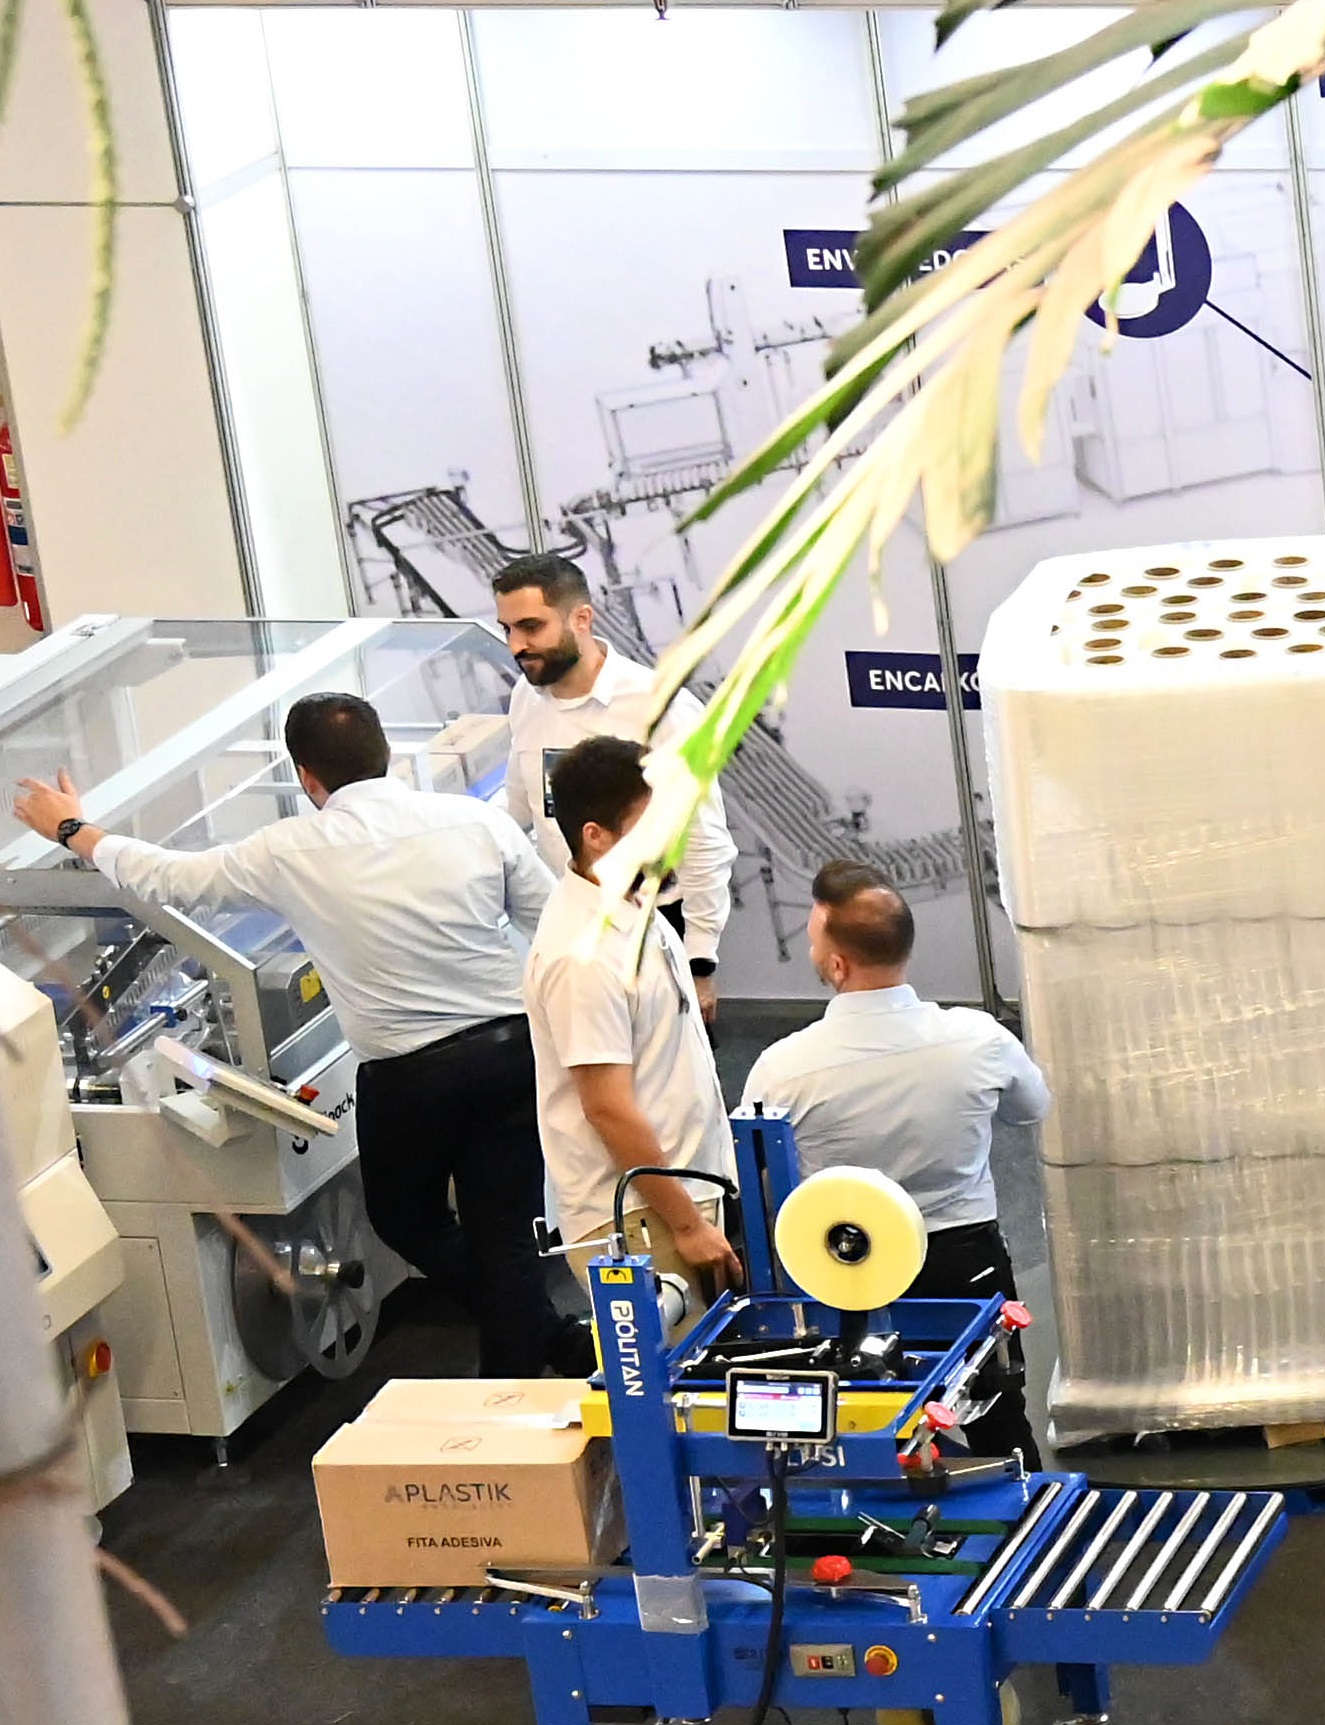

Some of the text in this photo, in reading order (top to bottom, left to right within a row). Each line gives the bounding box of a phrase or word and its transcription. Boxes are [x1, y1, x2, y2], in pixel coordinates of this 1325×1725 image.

[610, 1300, 645, 1396] PÓLITAN
[407, 1537, 503, 1548] FITA ADESIVA
